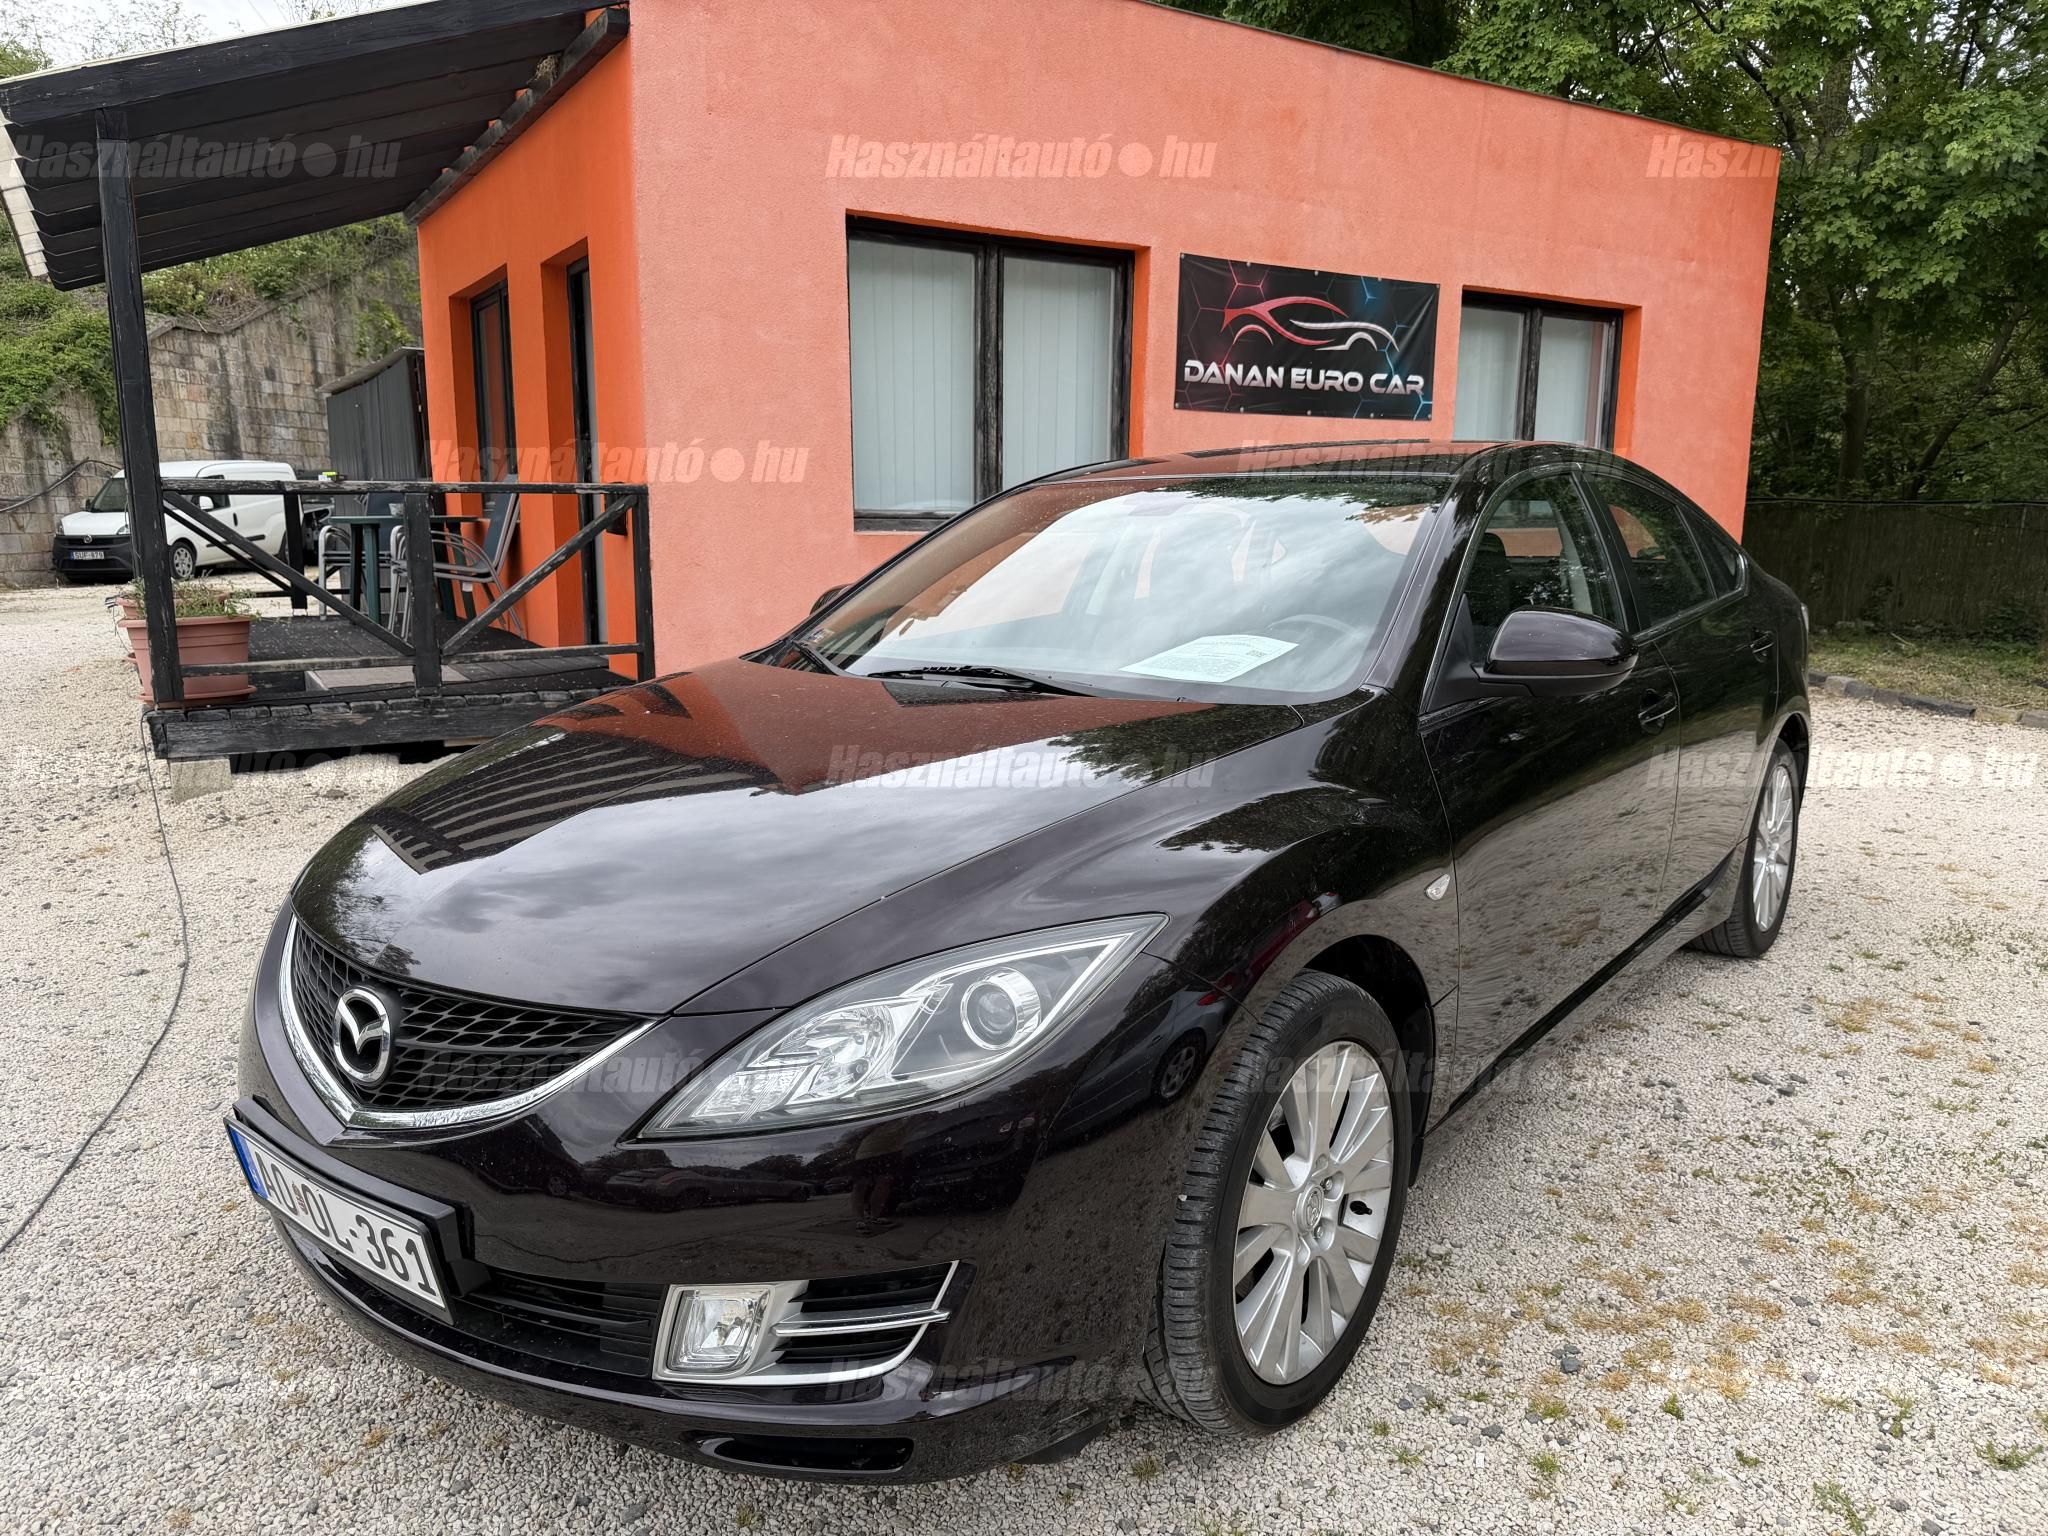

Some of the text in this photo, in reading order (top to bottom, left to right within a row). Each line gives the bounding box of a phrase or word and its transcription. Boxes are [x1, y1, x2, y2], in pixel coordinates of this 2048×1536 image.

[1184, 359, 1425, 396] DANAN EURO CAR
[255, 1151, 437, 1297] AO OL-361
